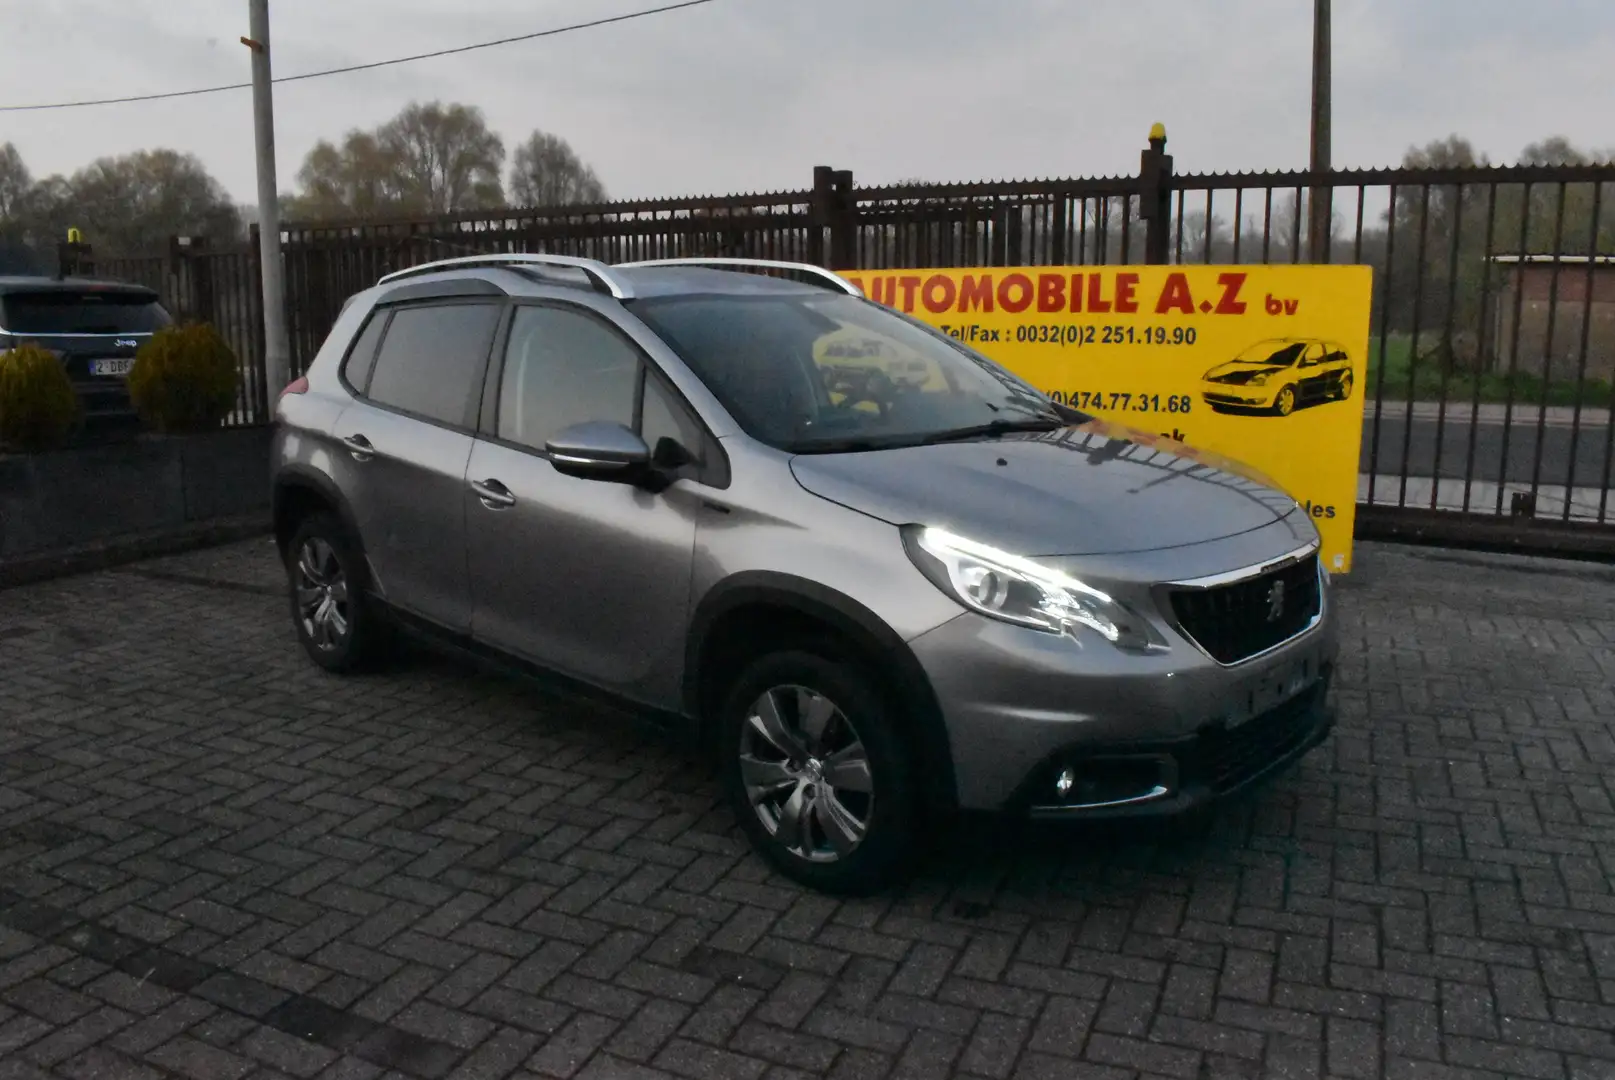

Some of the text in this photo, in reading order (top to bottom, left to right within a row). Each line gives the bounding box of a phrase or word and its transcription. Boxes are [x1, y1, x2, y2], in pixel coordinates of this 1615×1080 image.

[1155, 273, 1247, 314] A.Z
[1264, 293, 1298, 315] bv
[941, 325, 999, 343] Tel/Fax
[1016, 325, 1095, 347] 0032(0)2
[1102, 325, 1196, 344] 251.19.90
